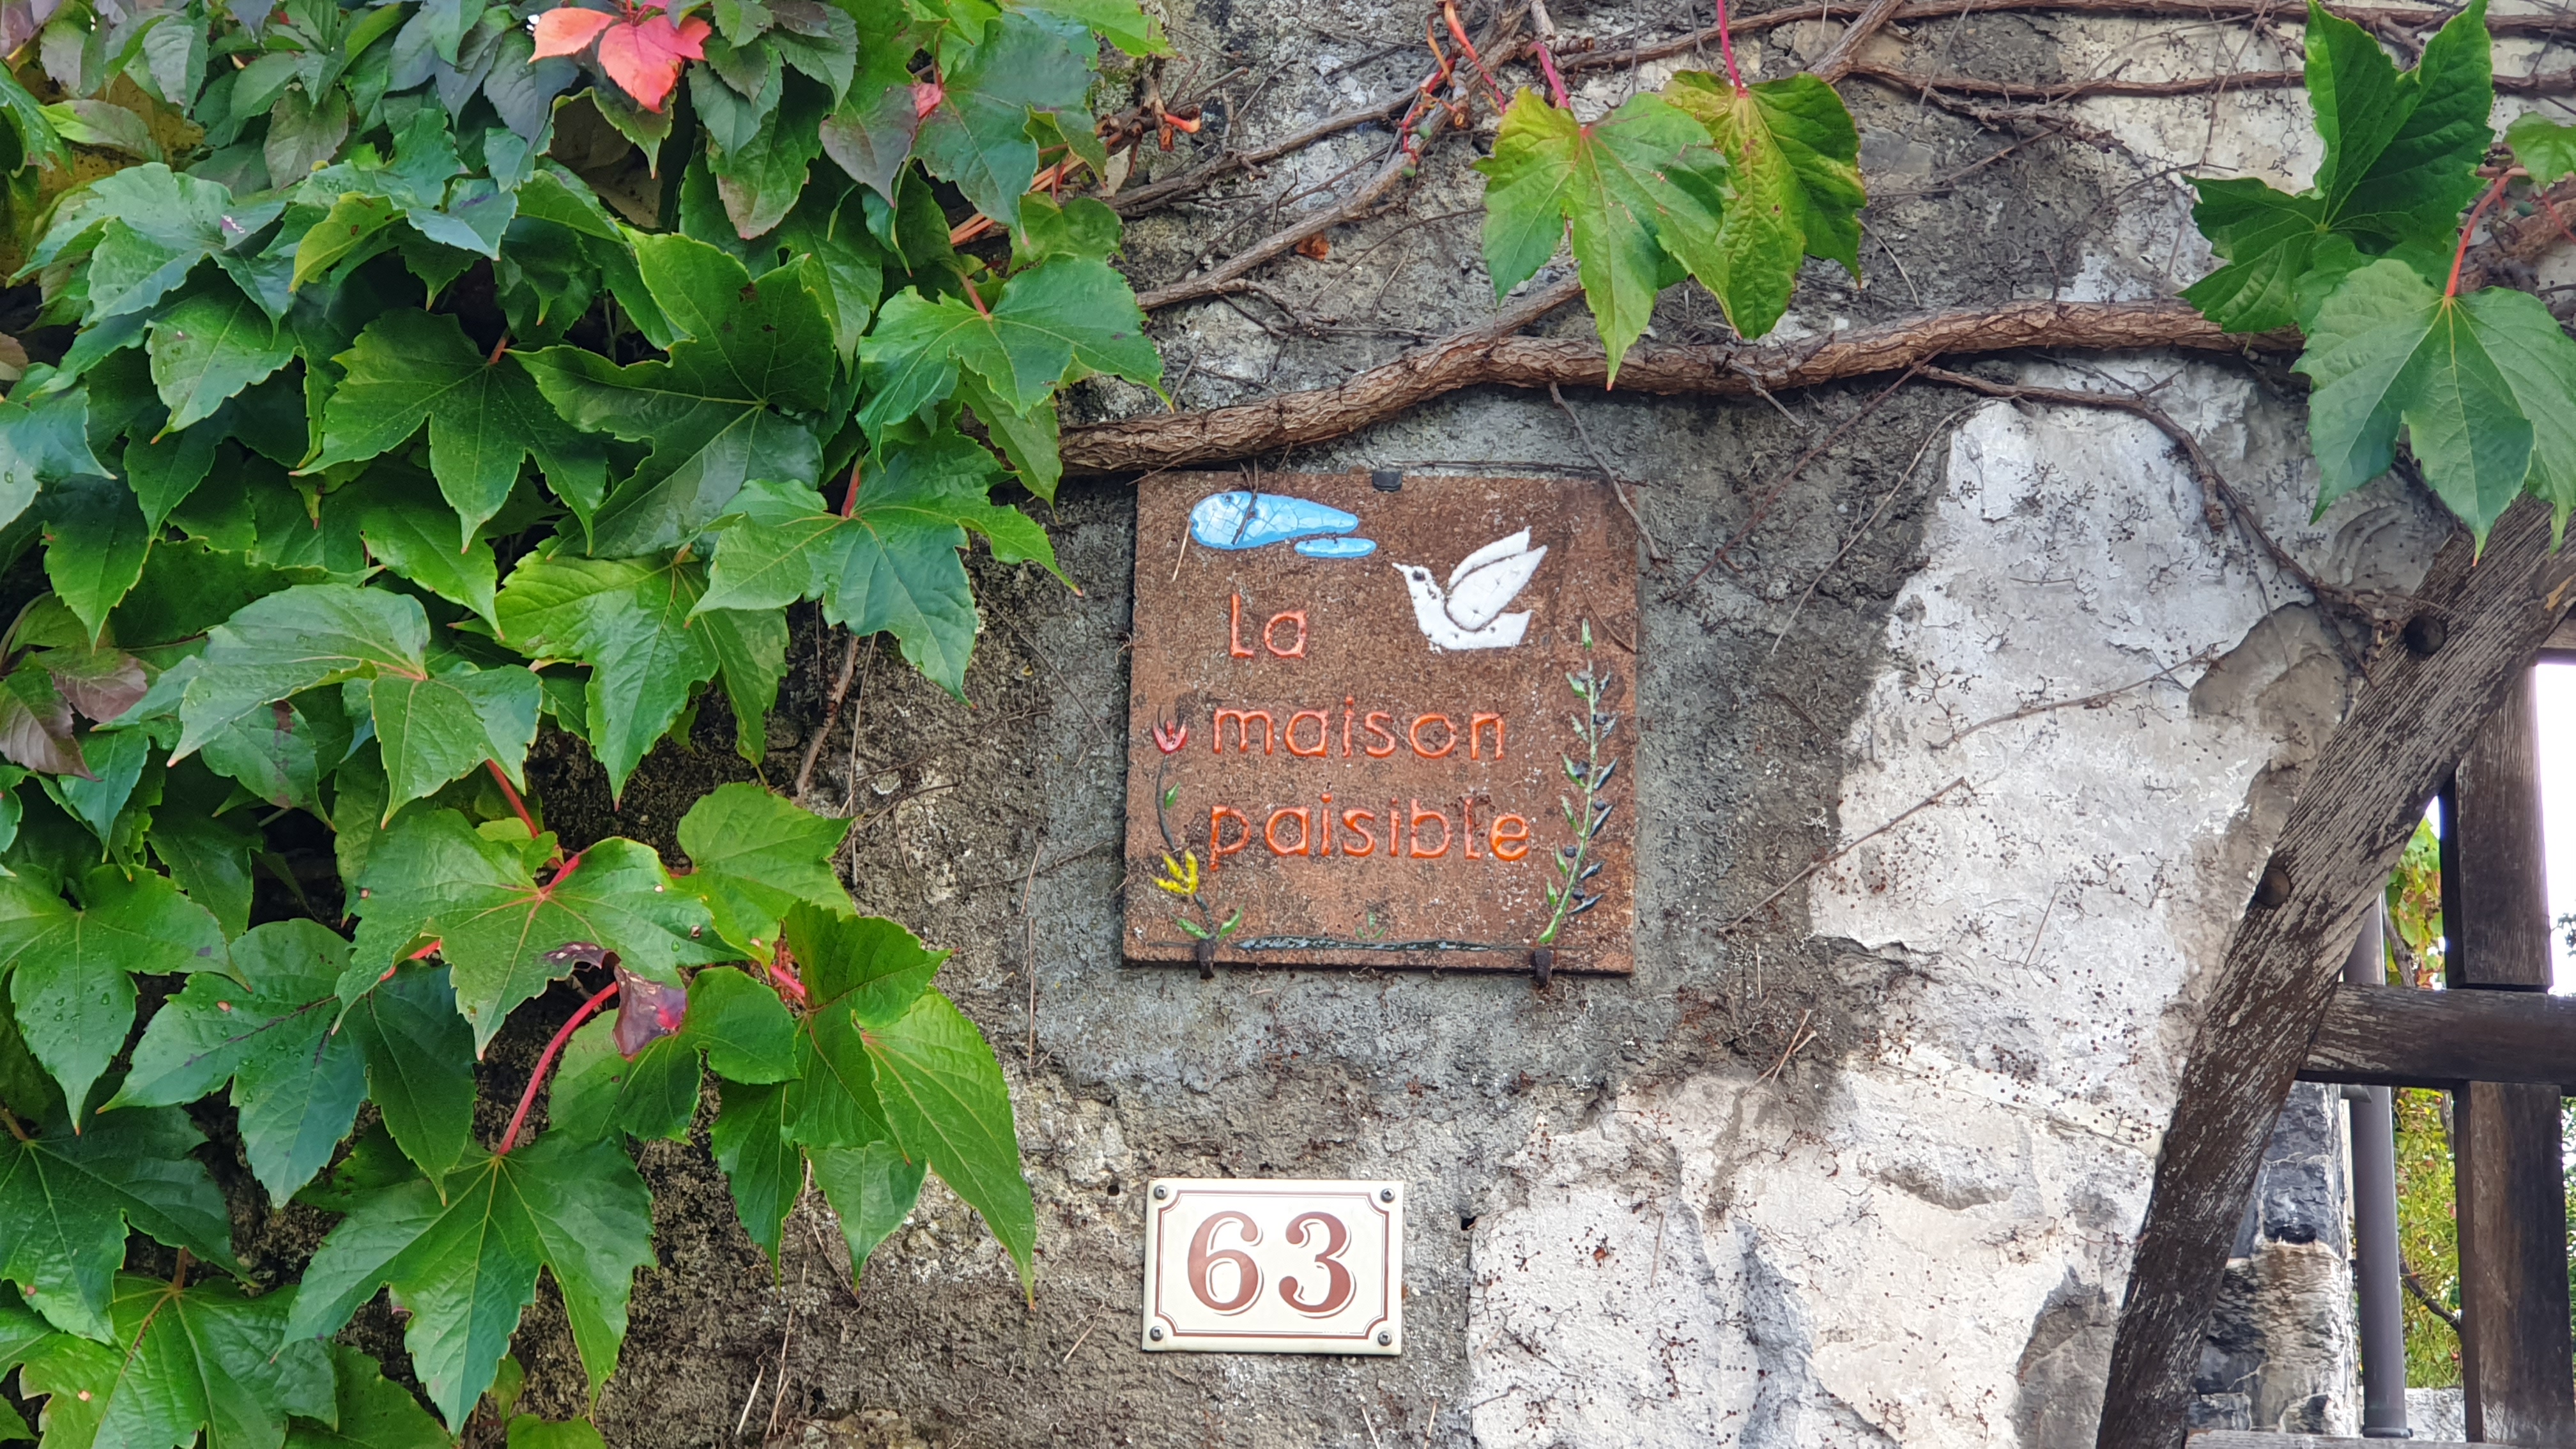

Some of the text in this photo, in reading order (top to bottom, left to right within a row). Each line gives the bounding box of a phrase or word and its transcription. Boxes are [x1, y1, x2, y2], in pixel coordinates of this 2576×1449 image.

[1229, 594, 1308, 659] La
[1212, 694, 1505, 760] maison
[1208, 791, 1530, 871] paisible
[1187, 1210, 1356, 1319] 63
